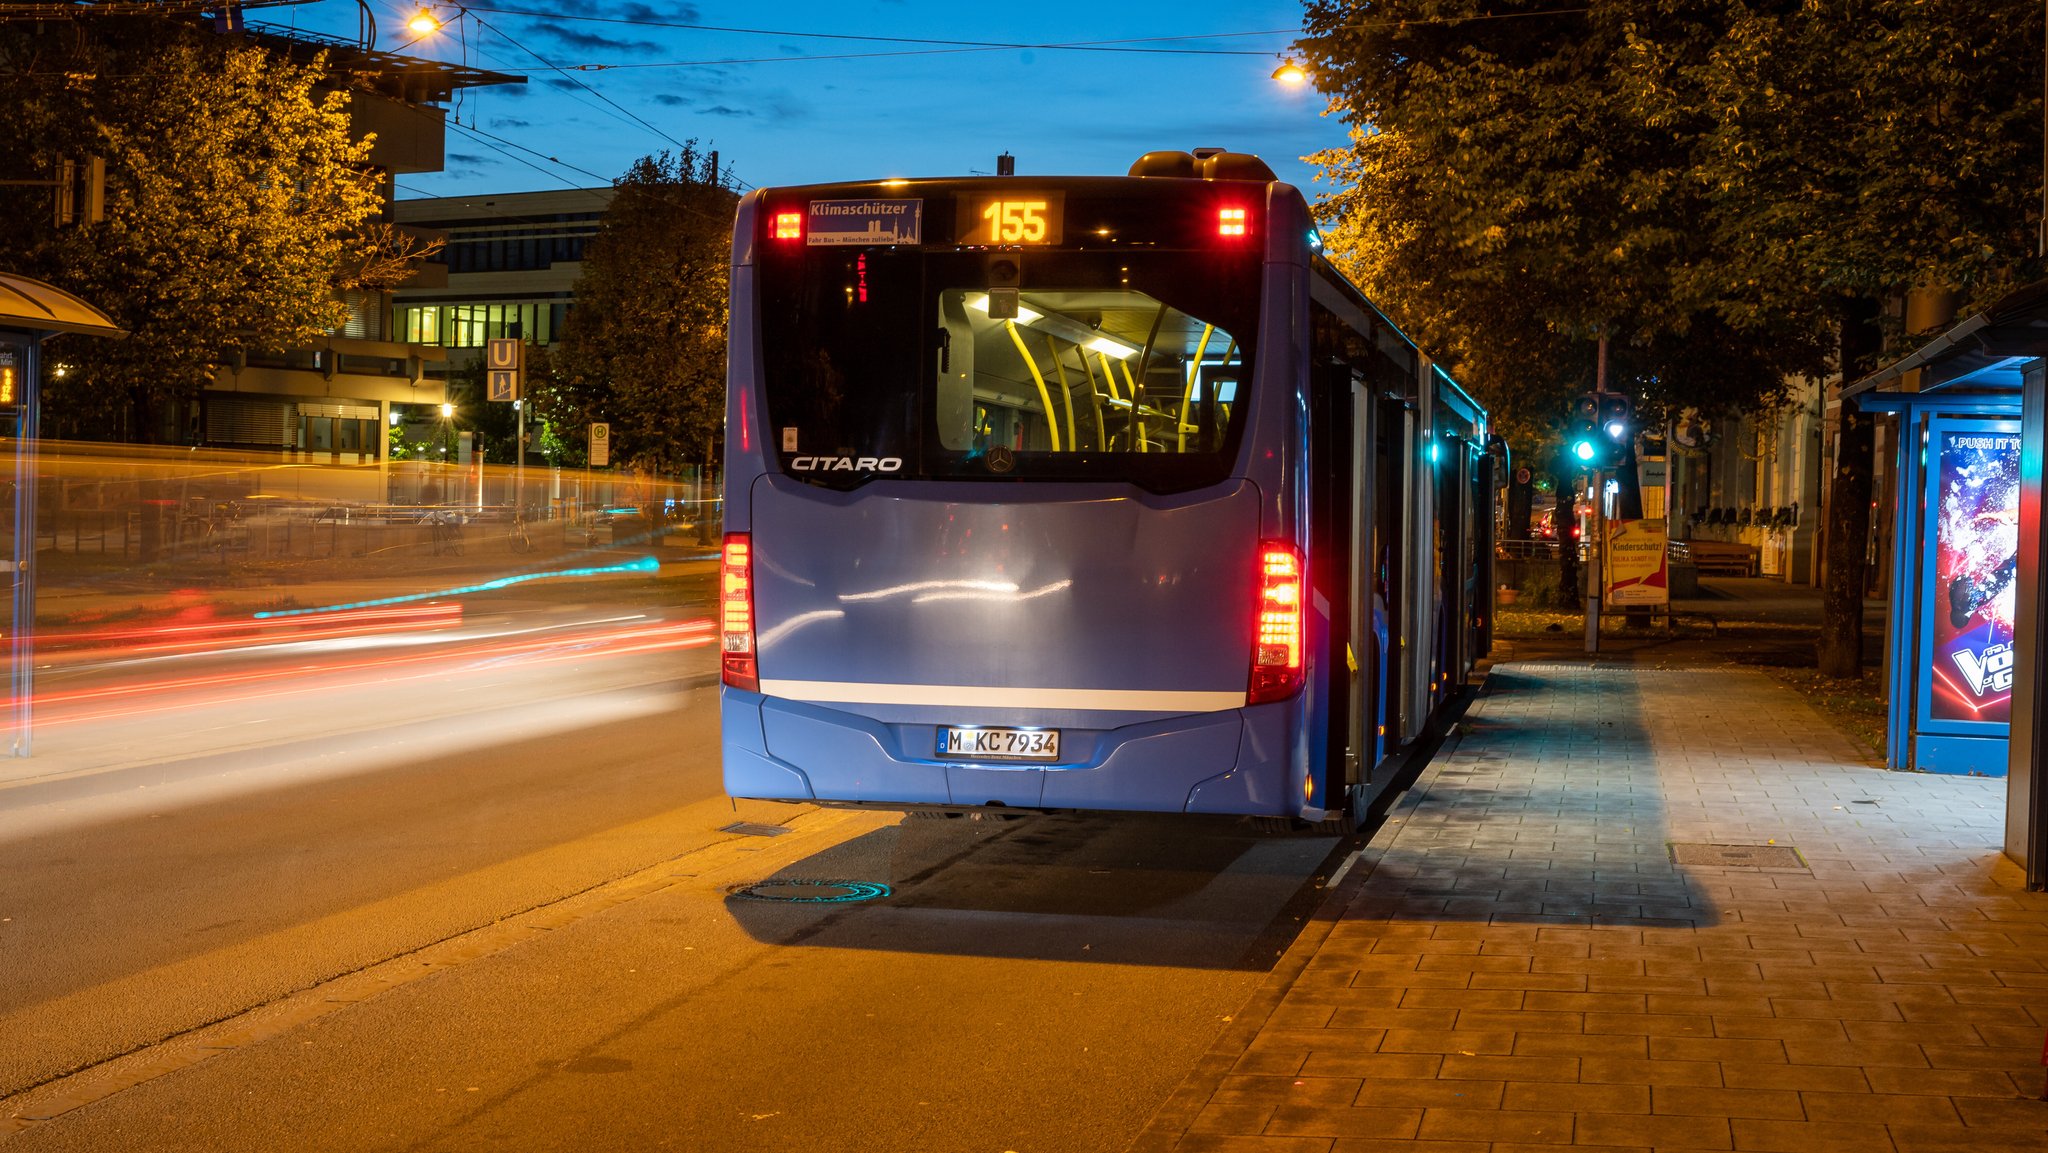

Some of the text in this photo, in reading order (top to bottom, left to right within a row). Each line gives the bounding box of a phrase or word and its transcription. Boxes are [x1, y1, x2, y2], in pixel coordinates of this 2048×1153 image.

[811, 203, 907, 216] Klimaschützer
[984, 202, 1046, 241] 155
[494, 343, 512, 366] U
[1958, 437, 1994, 449] PUSH
[1995, 438, 2009, 450] IT
[791, 456, 902, 472] CITARO
[1612, 542, 1662, 551] Kinderschutz!
[949, 731, 961, 750] M
[975, 732, 1001, 751] KC
[1006, 733, 1055, 753] 7934
